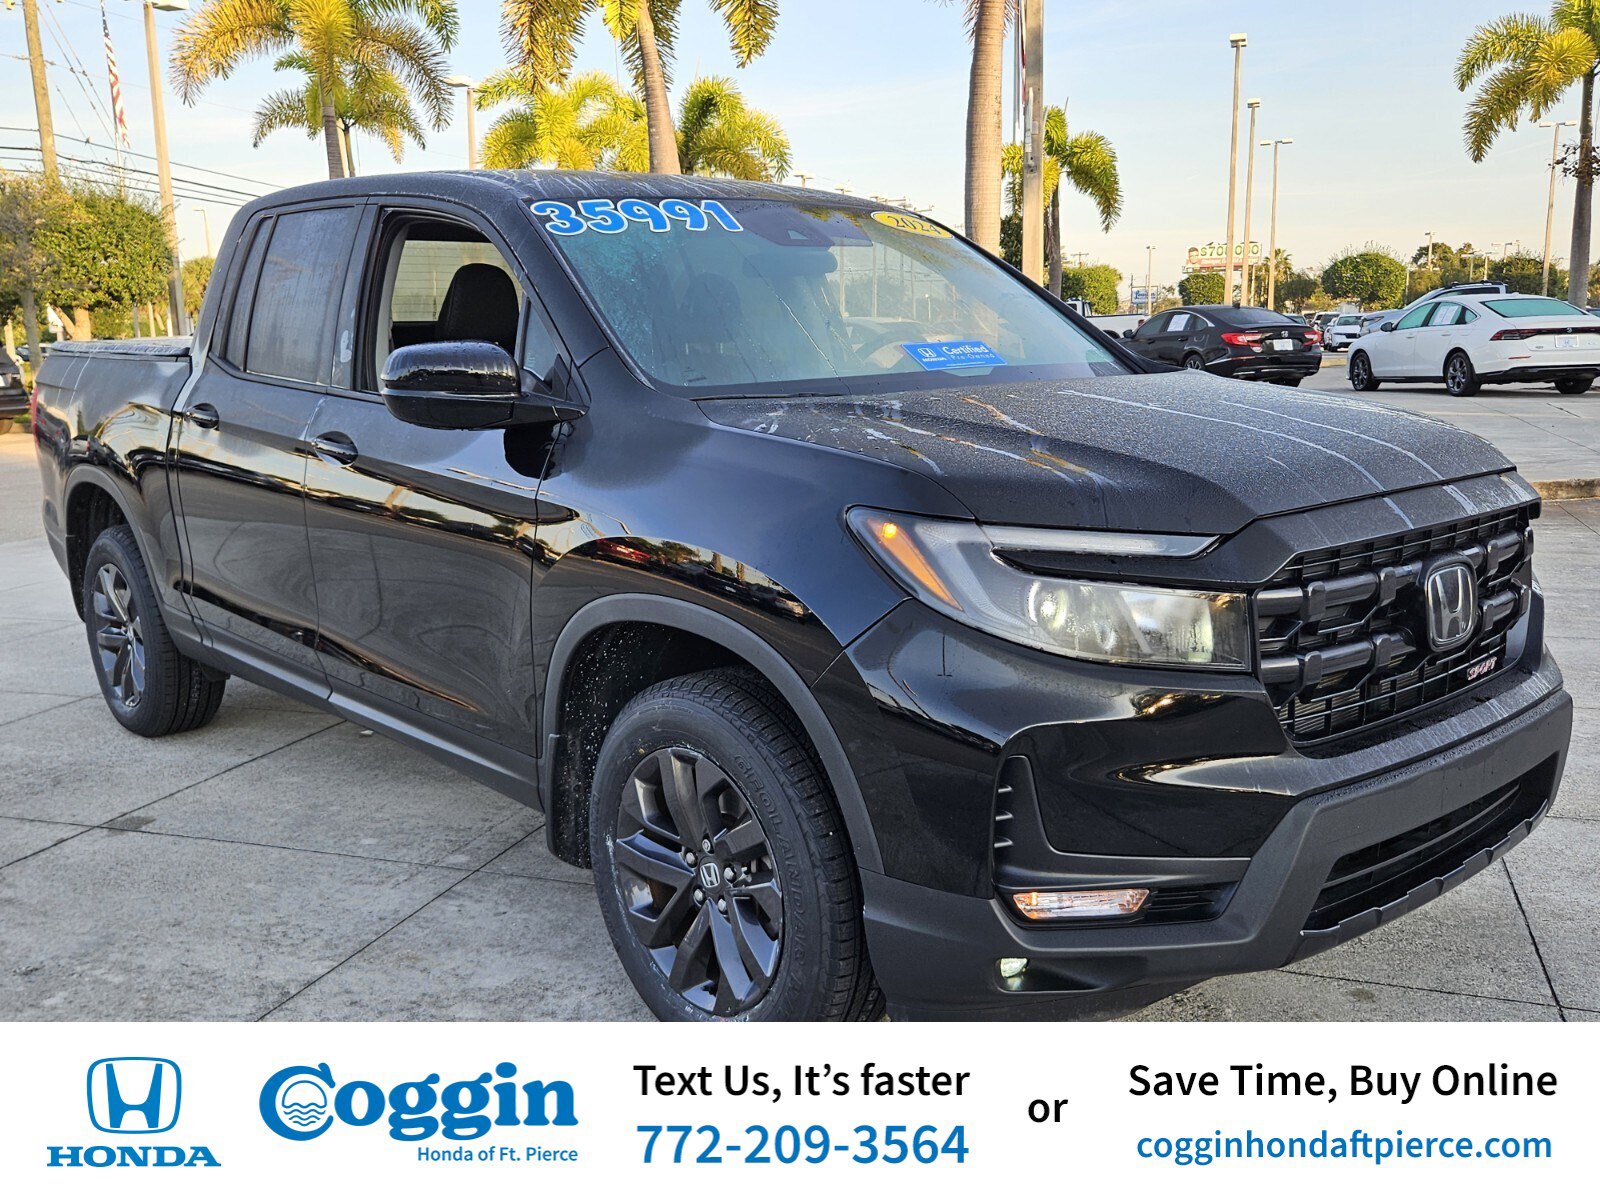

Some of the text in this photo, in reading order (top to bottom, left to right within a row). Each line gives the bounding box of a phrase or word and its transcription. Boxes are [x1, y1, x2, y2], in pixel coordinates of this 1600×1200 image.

[530, 198, 743, 235] 35991
[887, 215, 943, 235] 2024
[942, 344, 990, 355] Certified
